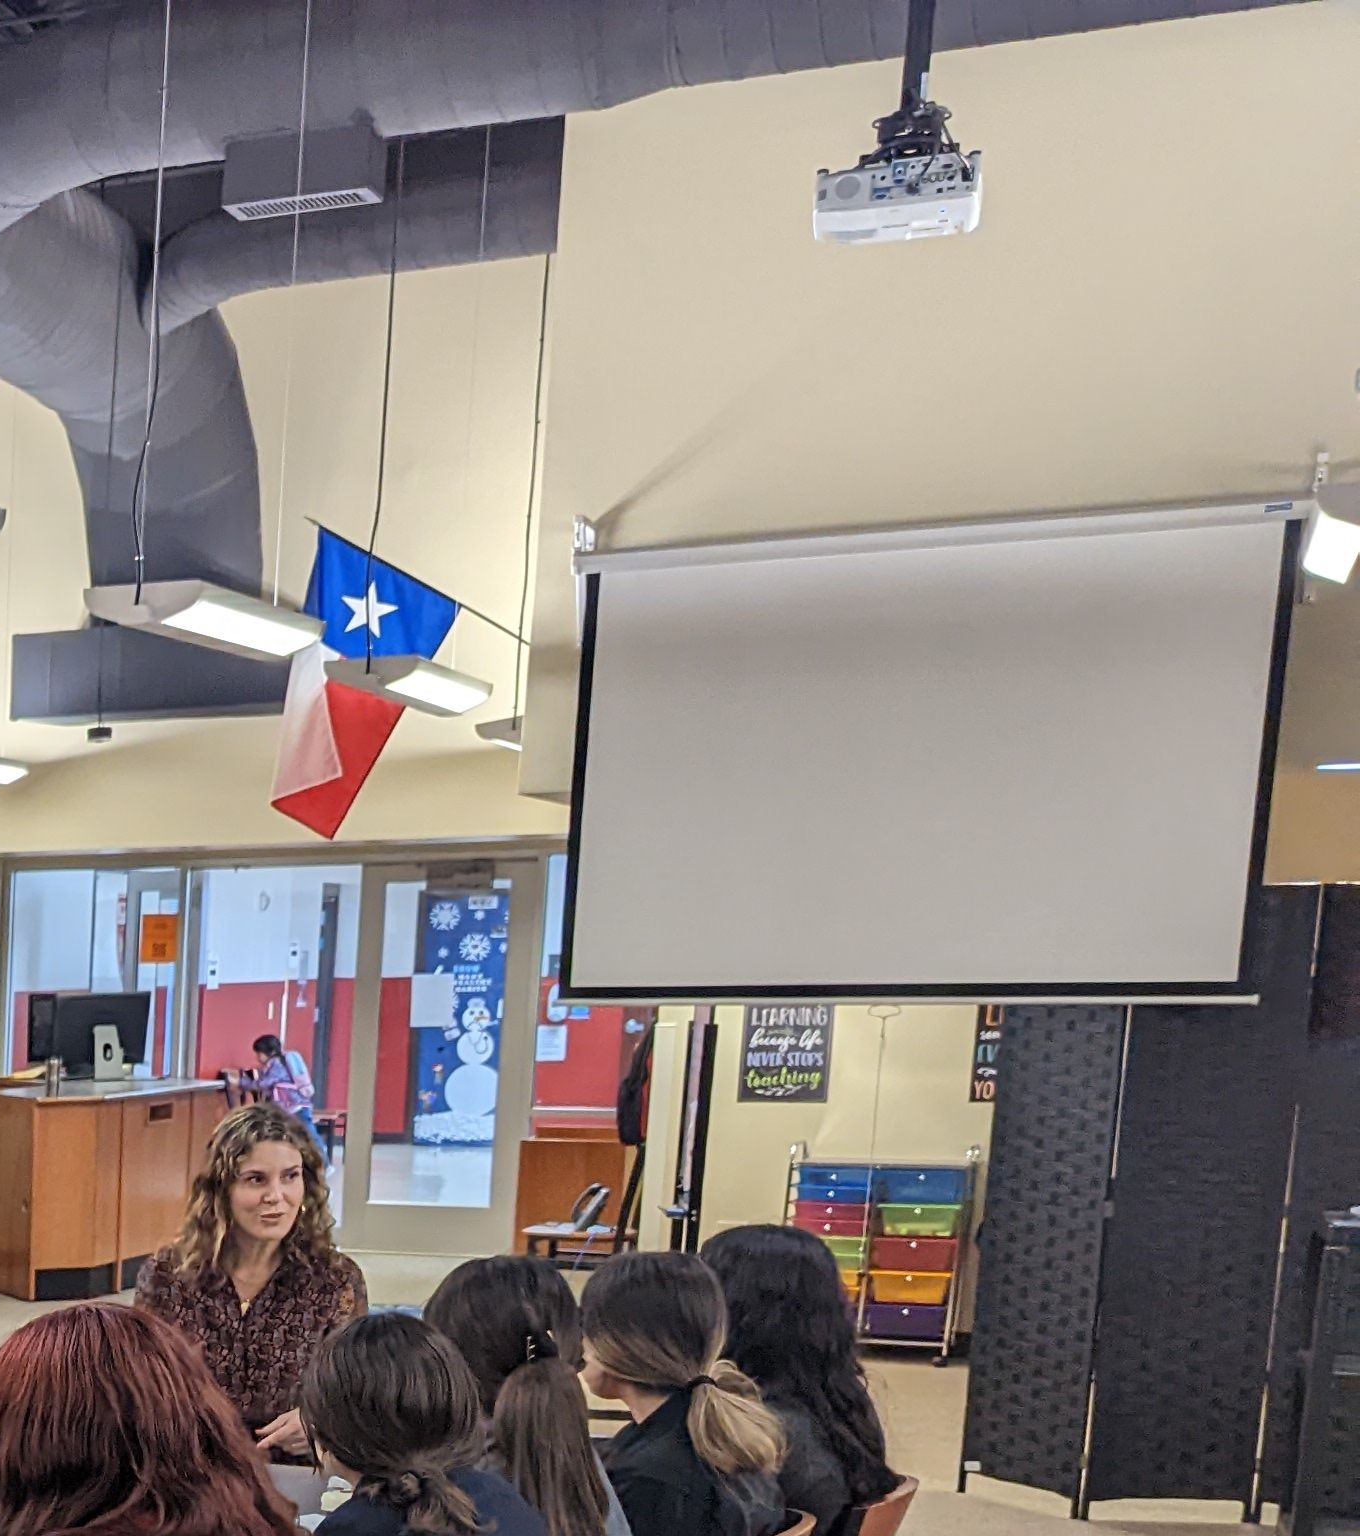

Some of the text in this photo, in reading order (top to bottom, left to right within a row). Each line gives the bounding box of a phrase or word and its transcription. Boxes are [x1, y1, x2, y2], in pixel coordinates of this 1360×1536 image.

[750, 1006, 828, 1027] LEARNING
[748, 1027, 825, 1052] because life
[746, 1051, 825, 1067] NEVER STOPS
[743, 1066, 822, 1091] teaching
